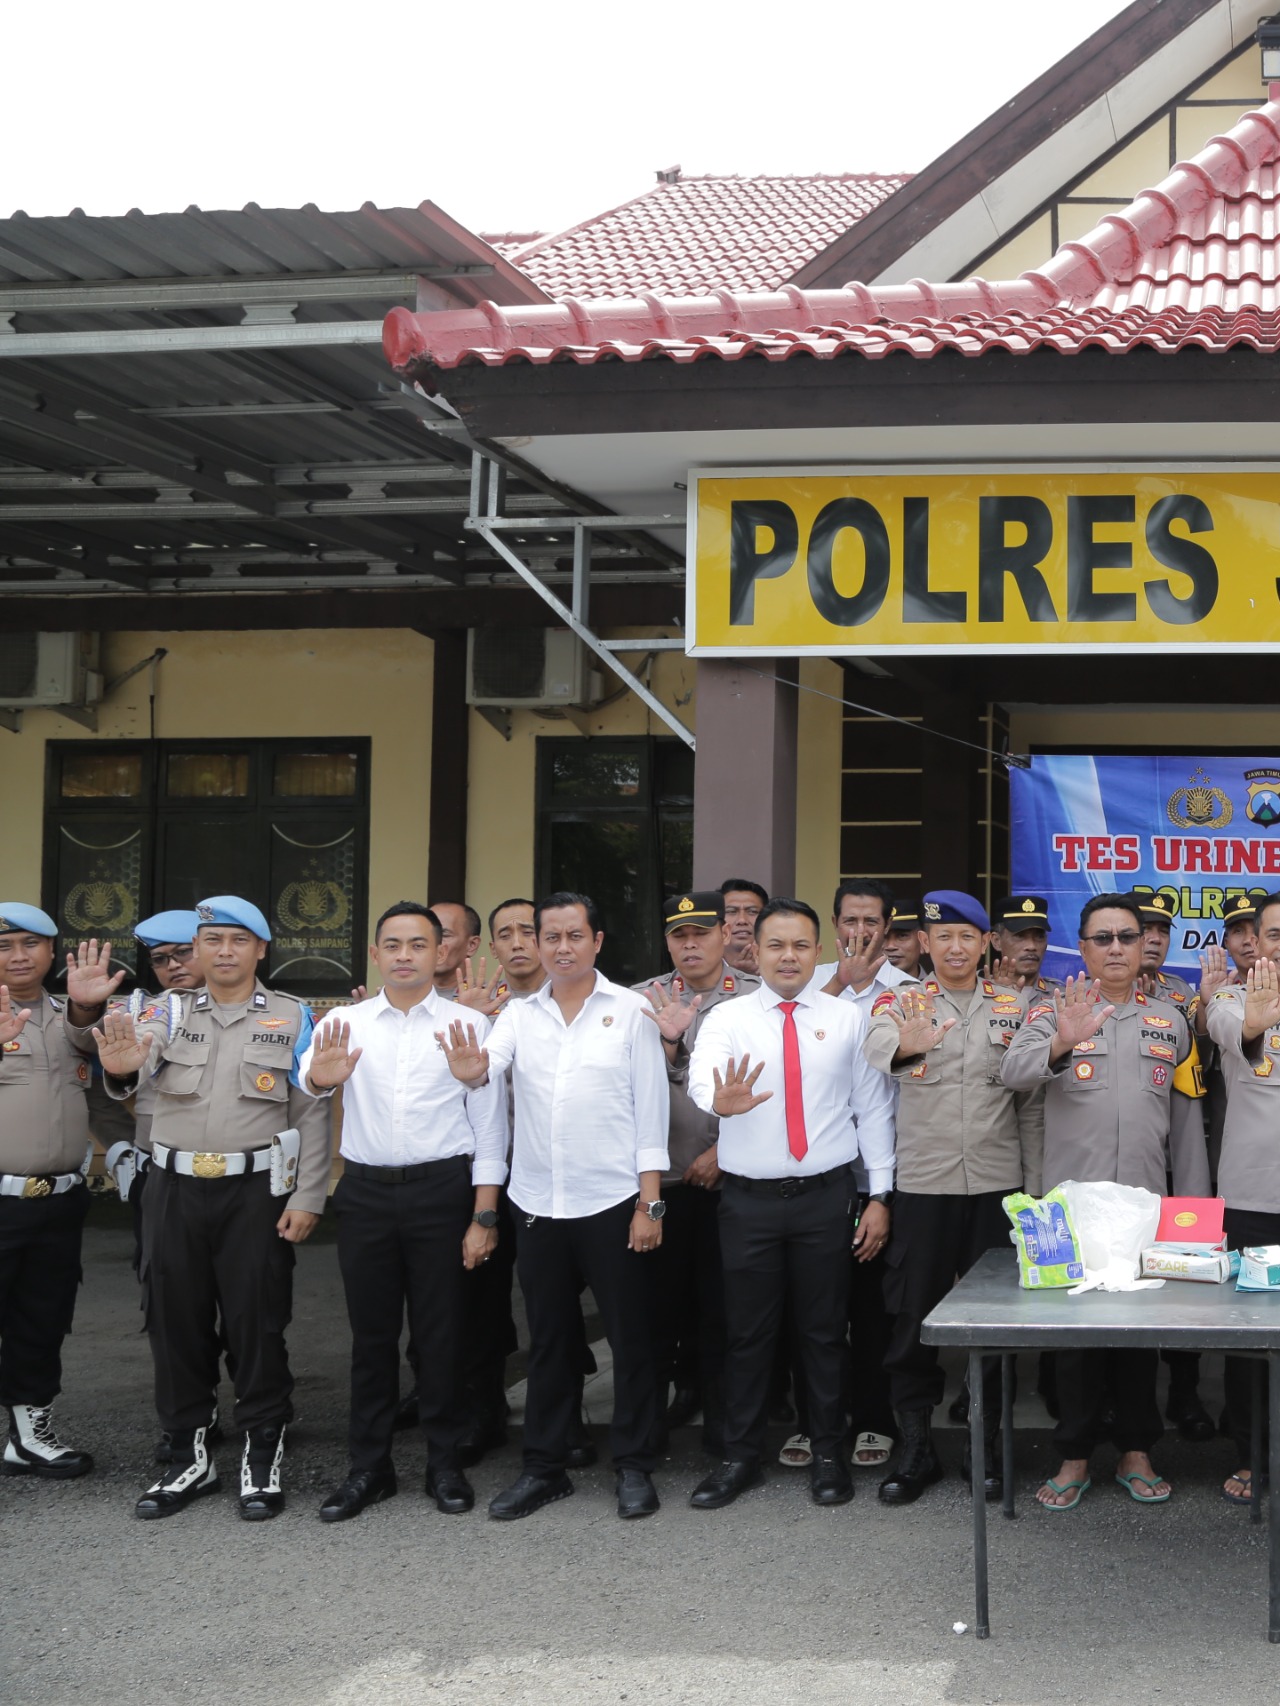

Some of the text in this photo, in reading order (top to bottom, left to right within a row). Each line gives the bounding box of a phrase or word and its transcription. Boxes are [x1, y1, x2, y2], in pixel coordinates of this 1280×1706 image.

[728, 493, 1219, 628] POLRES
[1246, 770, 1265, 779] JAWA
[1054, 836, 1139, 871] TES
[276, 937, 349, 948] POLRES SAMPANG
[252, 1033, 291, 1046] POLRI
[1141, 1029, 1177, 1045] POLRI
